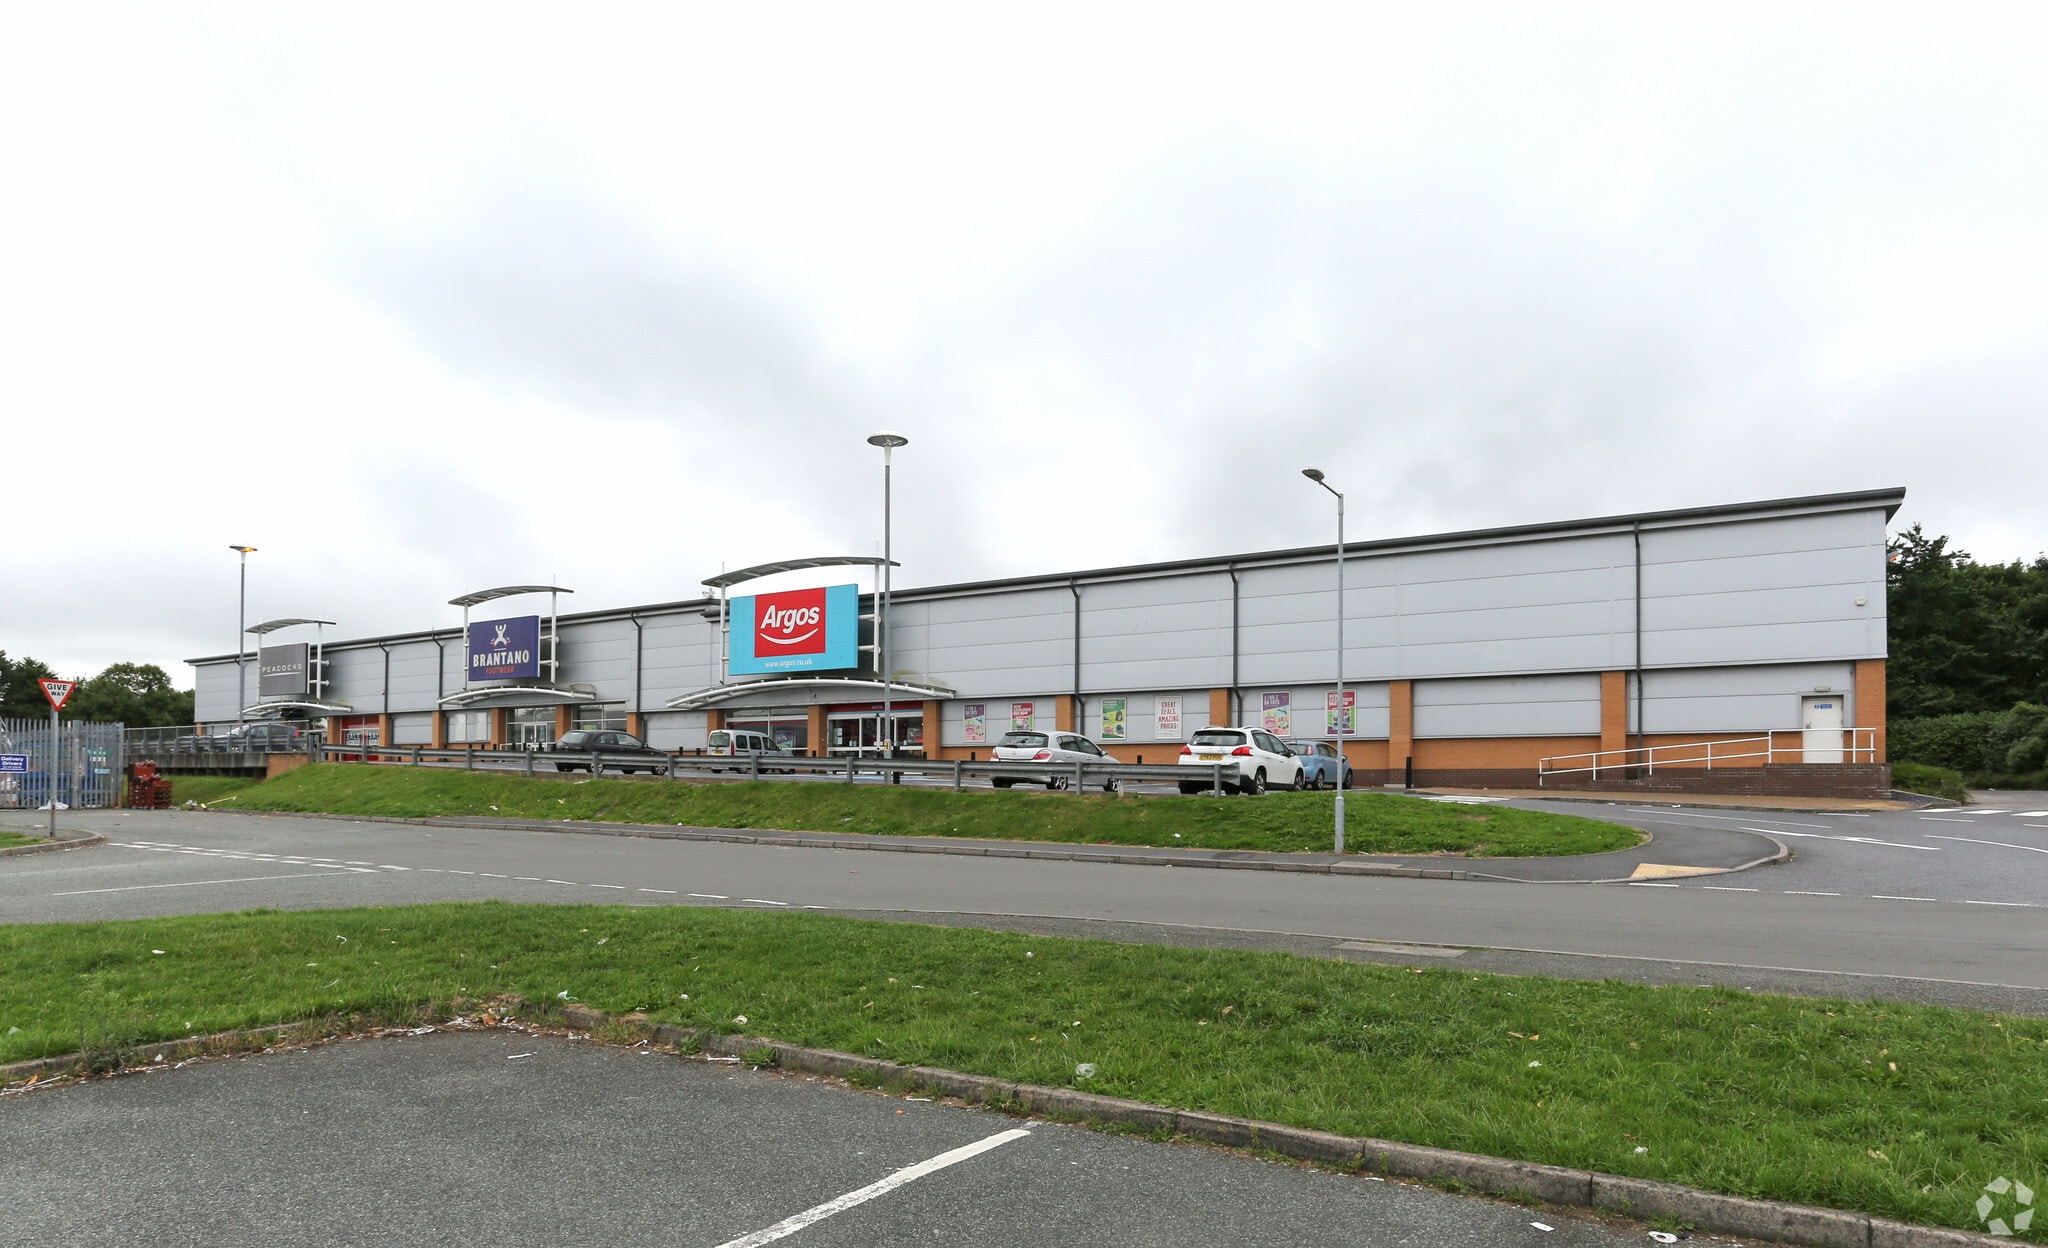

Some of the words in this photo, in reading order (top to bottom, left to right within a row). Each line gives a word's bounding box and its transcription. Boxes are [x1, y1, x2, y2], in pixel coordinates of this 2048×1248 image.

[760, 604, 820, 634] Argos
[473, 650, 530, 667] BRANTANO
[262, 663, 302, 673] PEACOCKS
[765, 659, 813, 668] www.argos.co.uk
[485, 666, 515, 675] FOOTWEAR
[46, 683, 67, 691] GIVE
